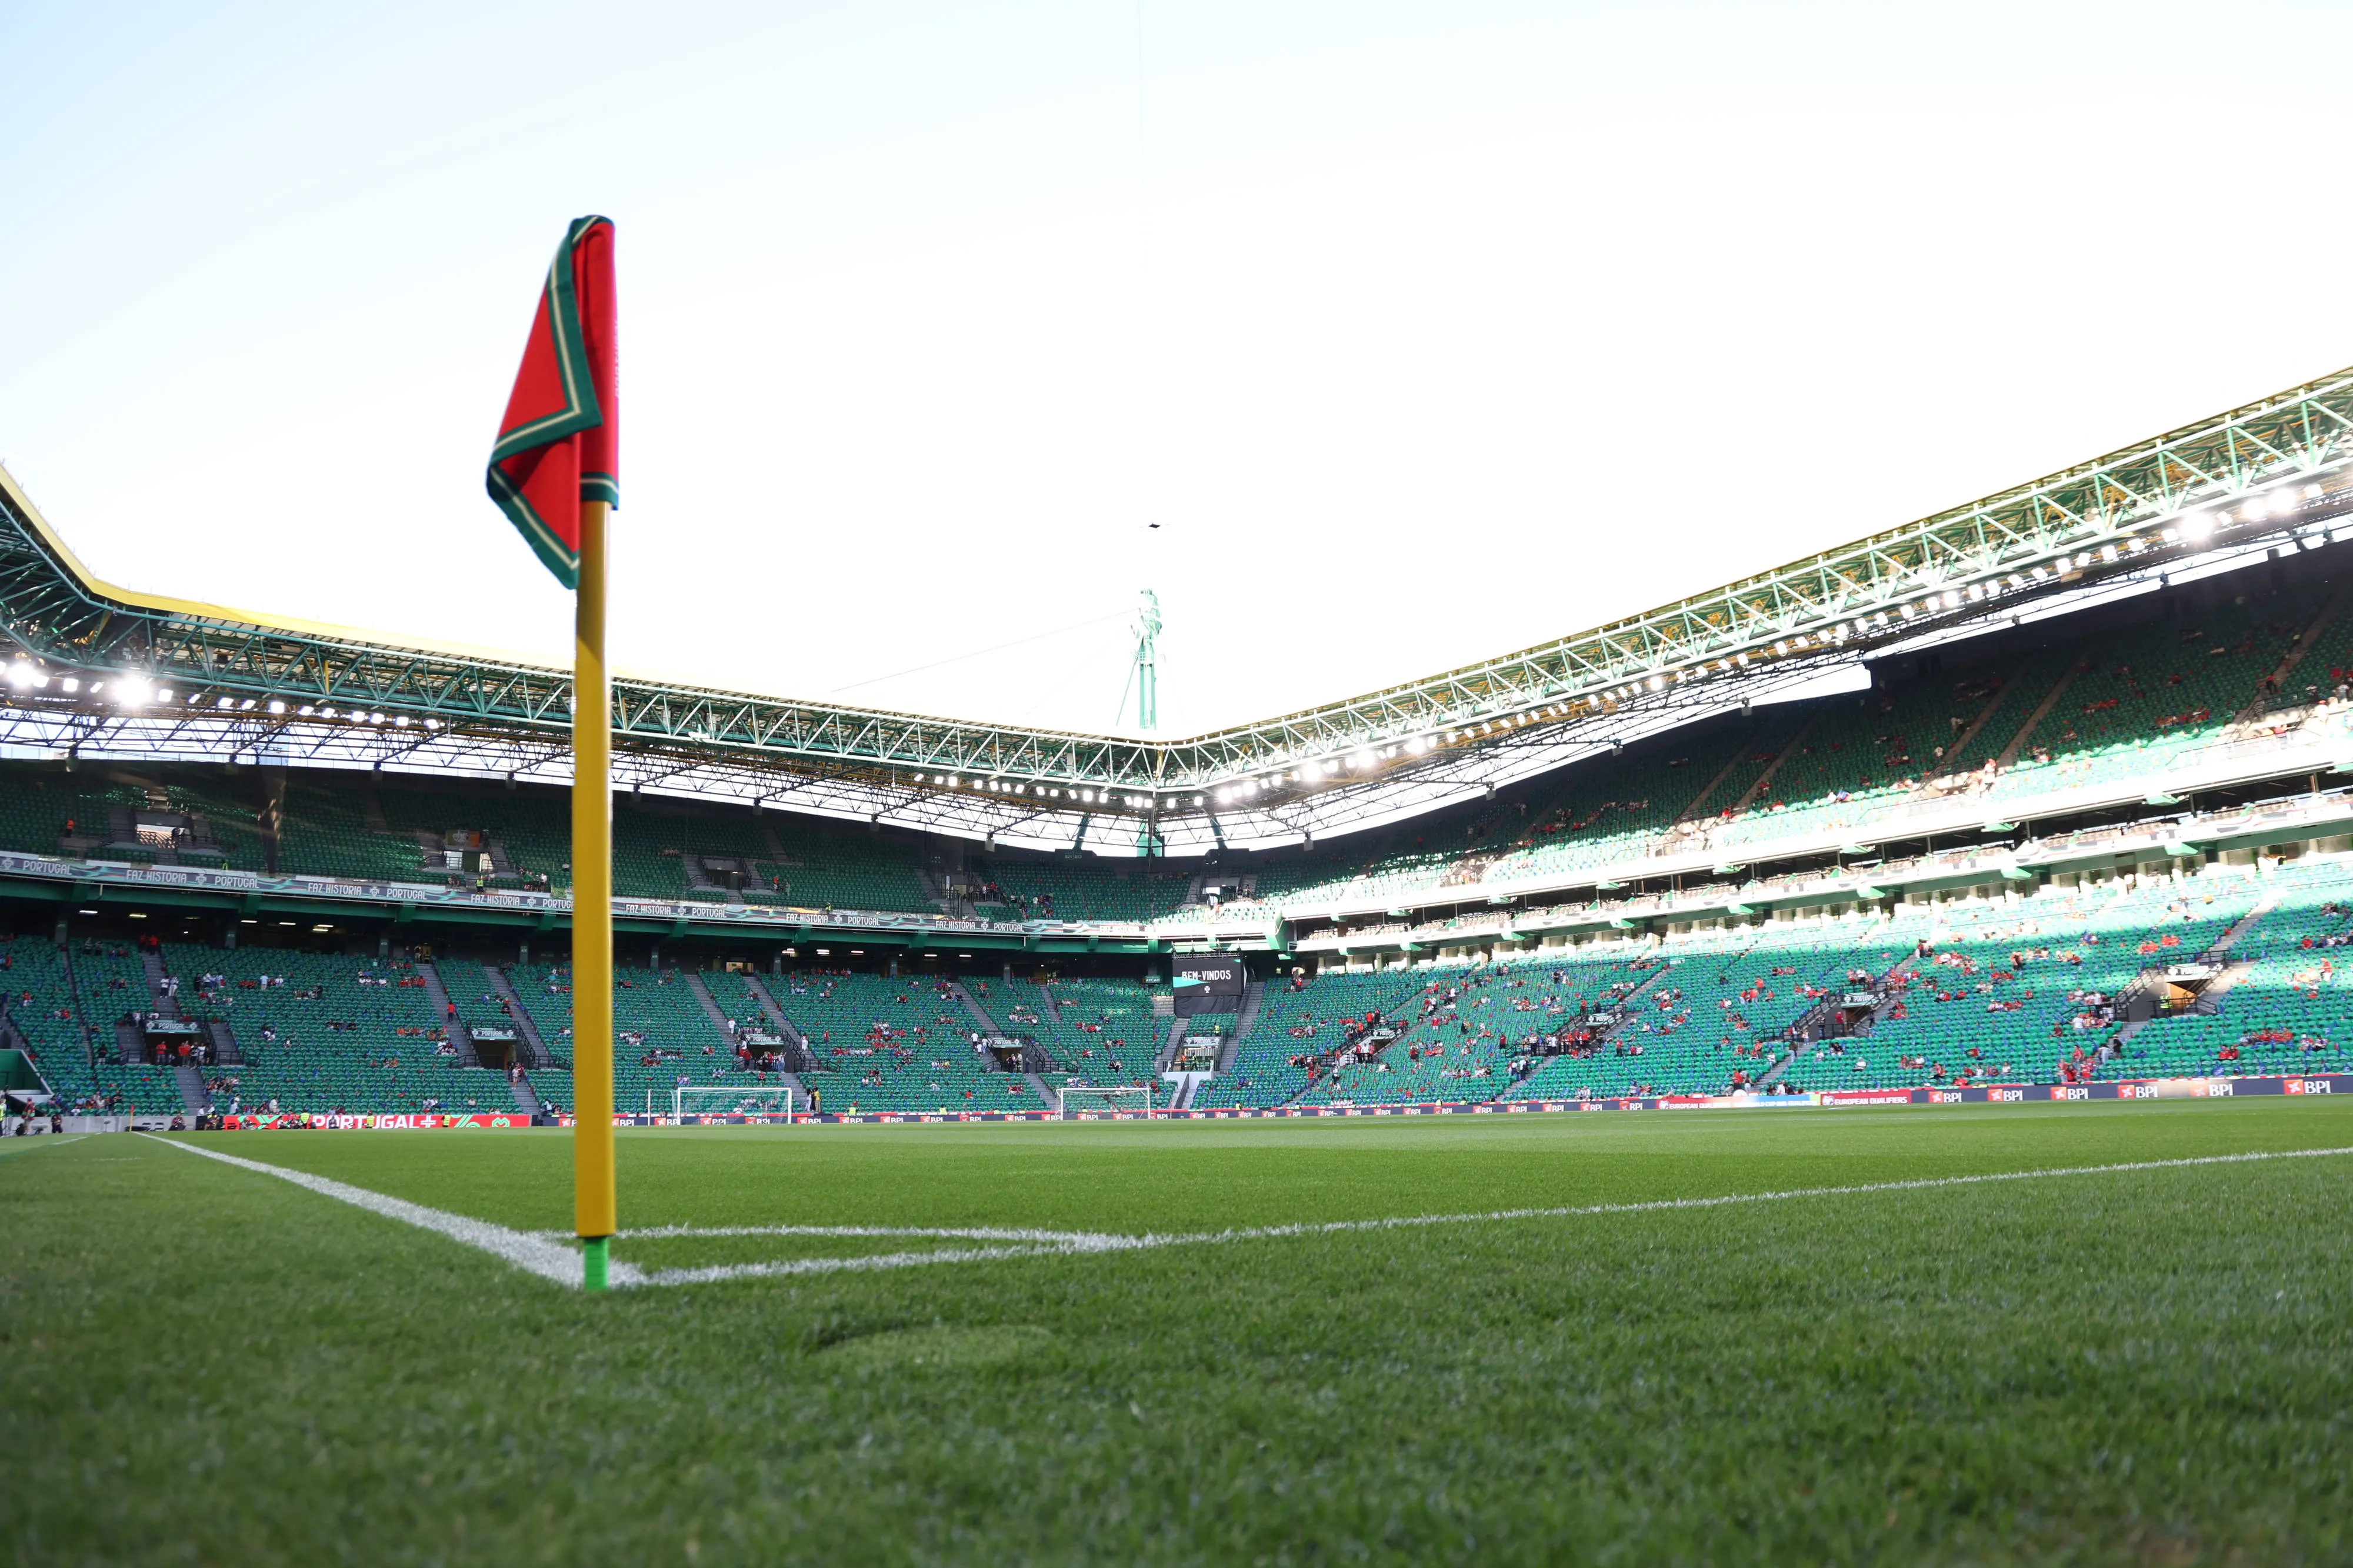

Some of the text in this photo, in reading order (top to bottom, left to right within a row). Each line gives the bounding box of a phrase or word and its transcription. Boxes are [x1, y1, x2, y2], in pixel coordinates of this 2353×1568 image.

[22, 860, 72, 875] PORTUGAL
[126, 869, 187, 883] FAZ HISTÓRIA
[215, 876, 259, 889] PORTUGAL
[308, 883, 362, 896] FAZ HISTÓRIA
[386, 888, 427, 900] PORTUGAL
[471, 894, 520, 906] FAZ HISTÓRIA
[626, 904, 671, 915] FAZ HISTÓRIA
[692, 908, 727, 918] PORTUGAL
[786, 913, 828, 923] FAZ HISTÓRIA
[848, 916, 880, 926] PORTUGAL
[935, 920, 975, 930] FAZ HISTÓRIA
[994, 923, 1024, 932] PORTUGAL
[1182, 970, 1231, 980] BEM-VINDOS
[2136, 1086, 2158, 1097] BPI
[2209, 1084, 2233, 1096] BPI
[2304, 1080, 2331, 1094] BPI
[1944, 1093, 1962, 1103] BPI
[2004, 1090, 2022, 1101] BPI
[2068, 1088, 2088, 1099] BPI
